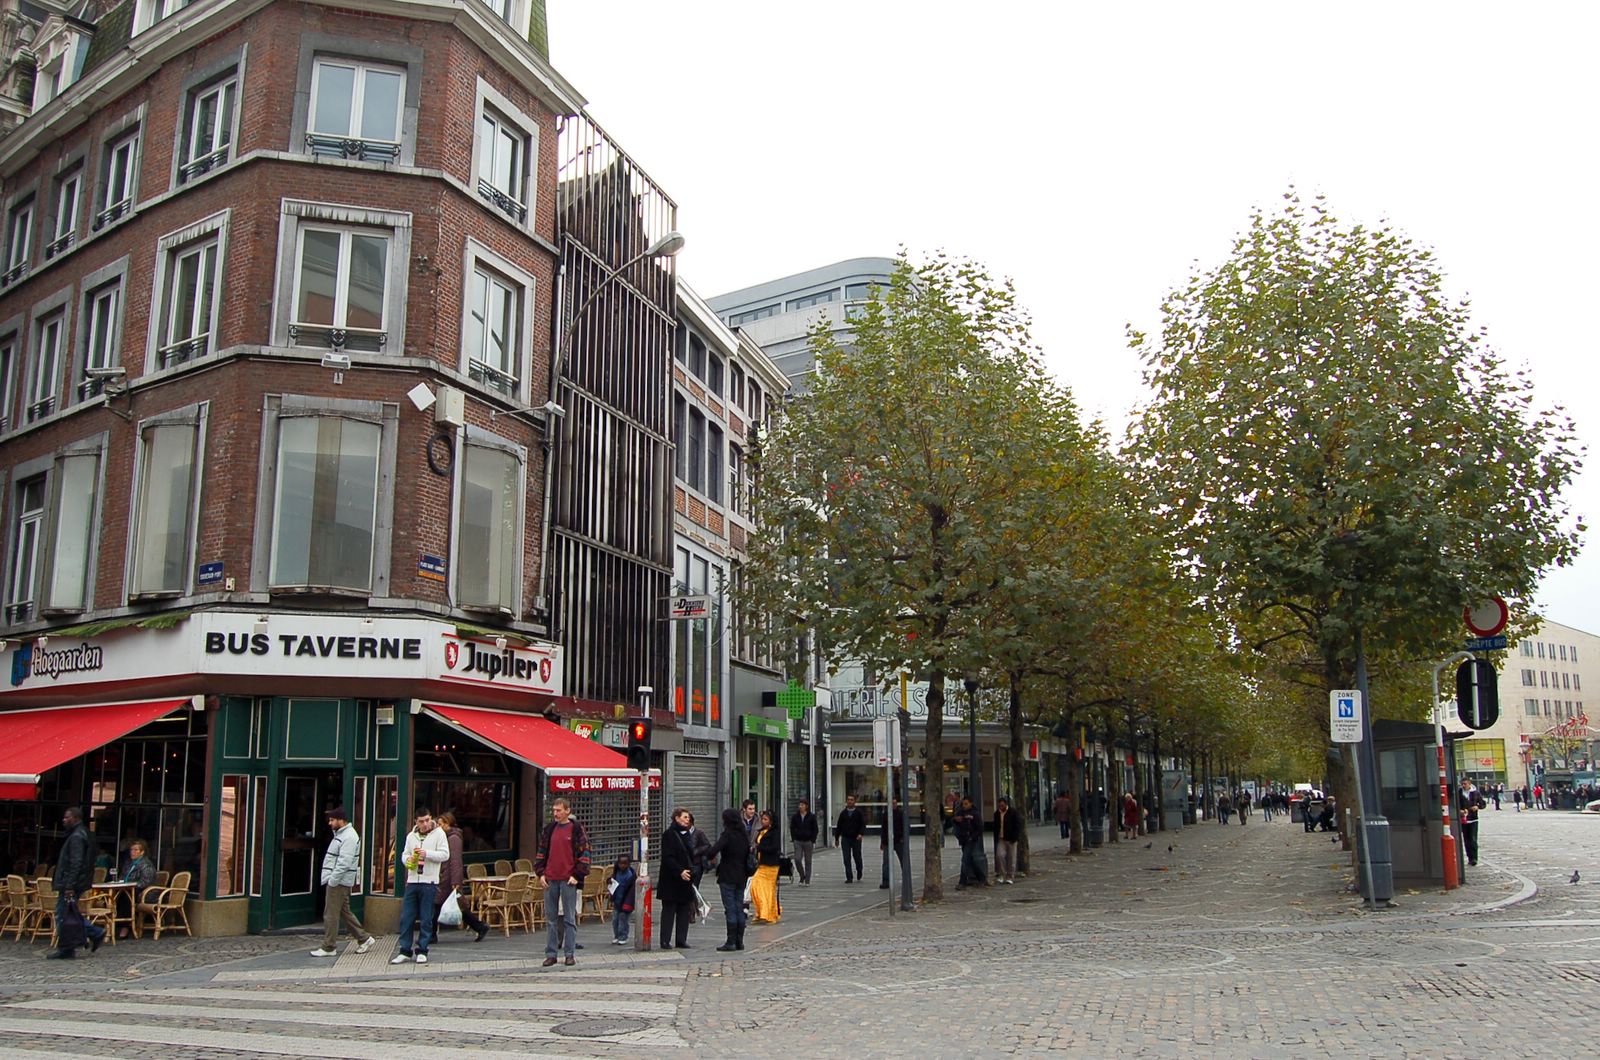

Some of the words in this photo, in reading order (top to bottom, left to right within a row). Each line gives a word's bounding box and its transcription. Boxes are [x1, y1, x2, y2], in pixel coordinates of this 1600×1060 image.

[205, 632, 270, 655] BUS
[278, 634, 421, 659] TAVERNE
[33, 643, 103, 680] Hoegaarden
[462, 642, 538, 680] Jupiler
[611, 729, 629, 744] LaM
[831, 747, 875, 760] noiseri
[581, 777, 589, 789] LE
[607, 777, 635, 789] TAVERNE
